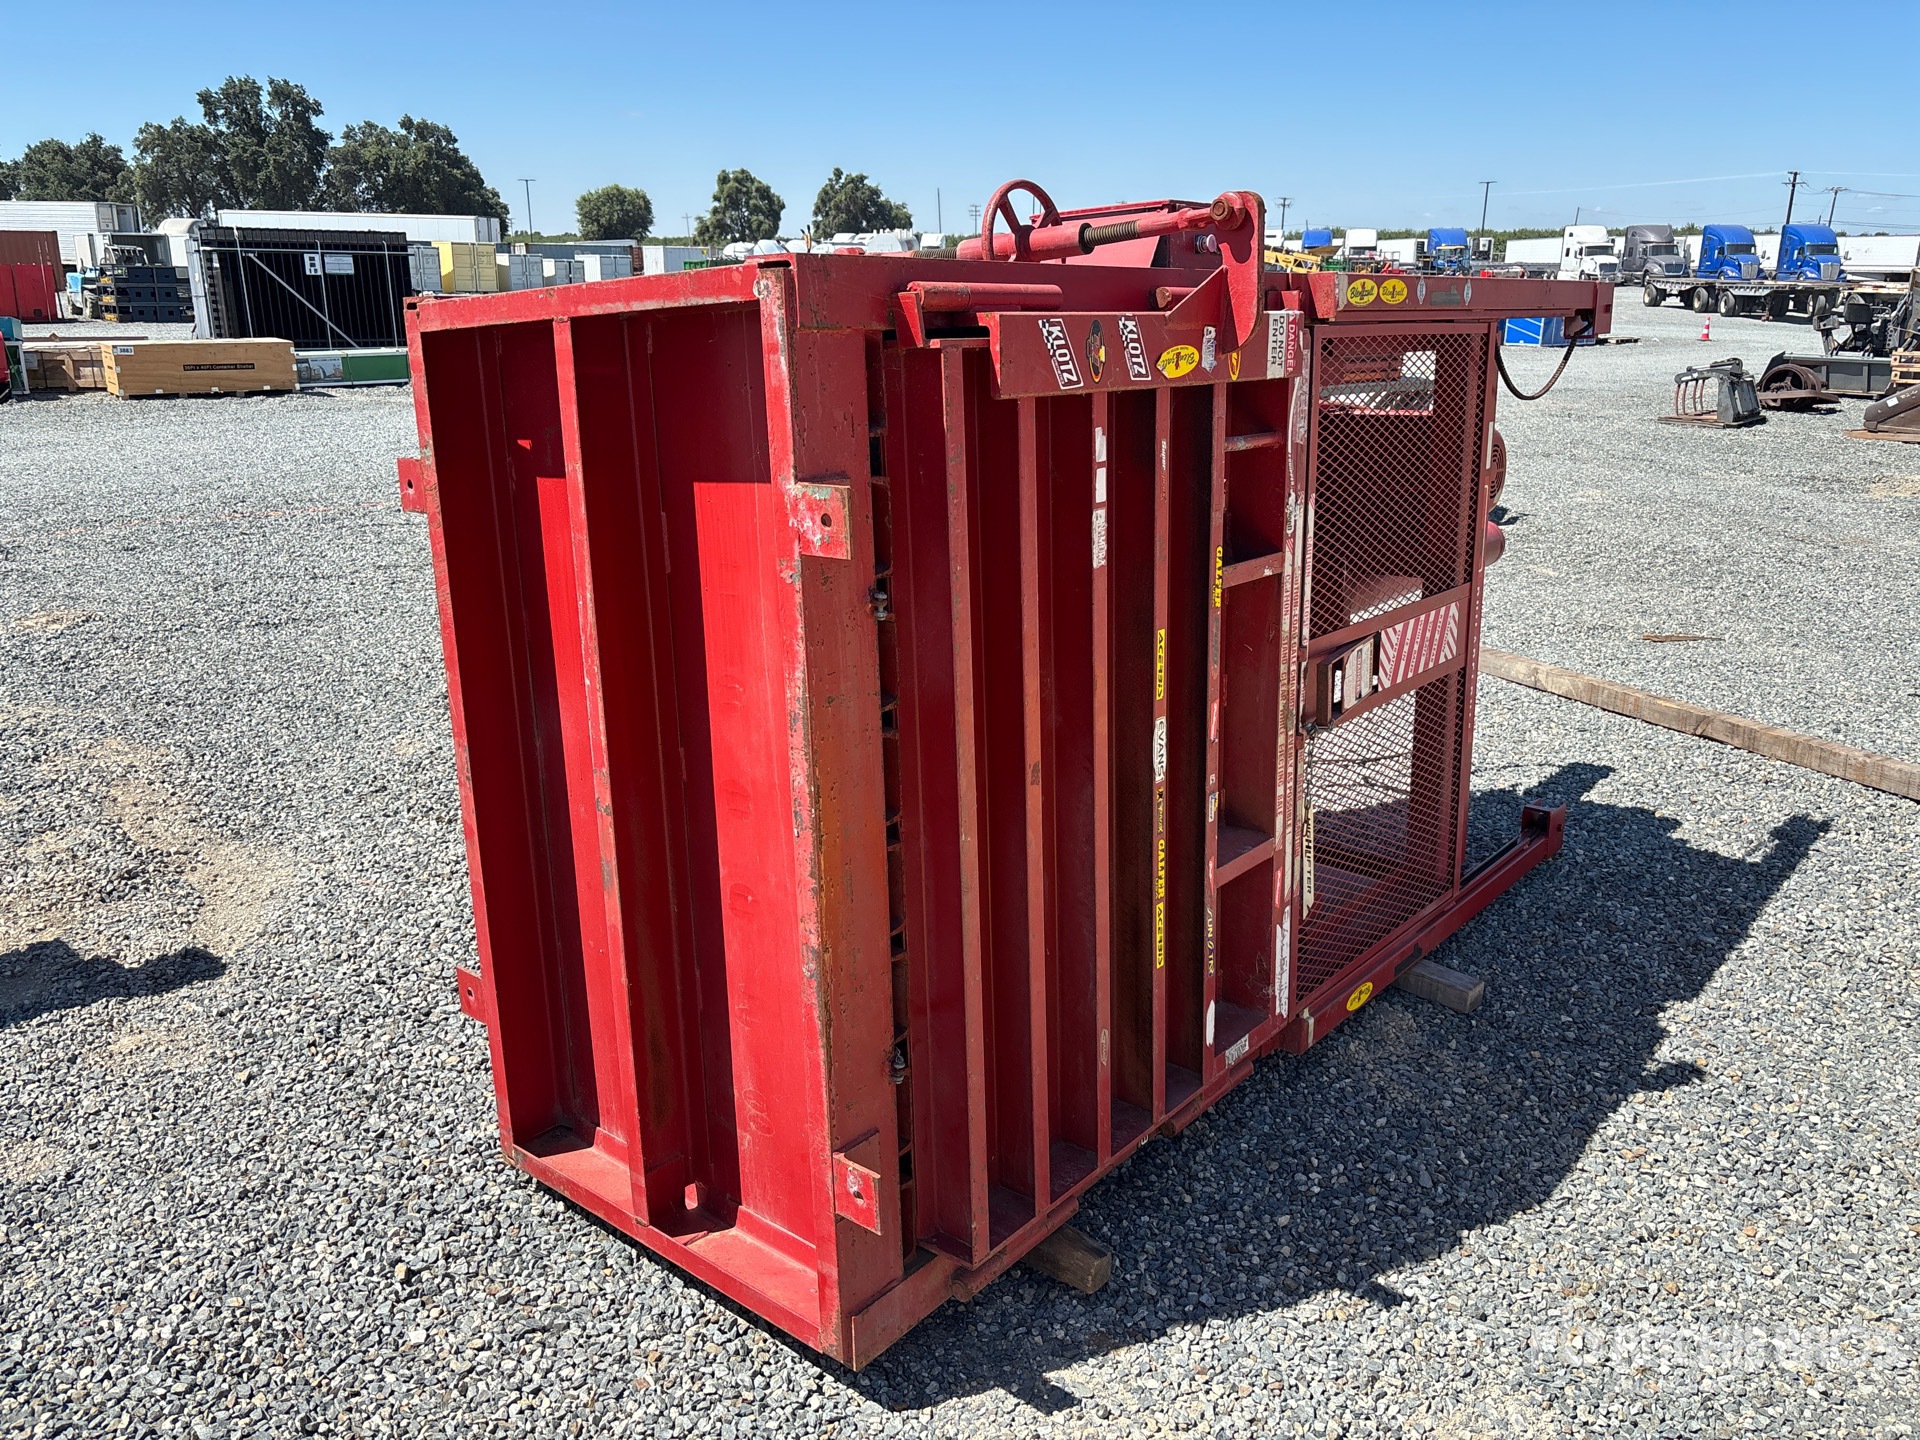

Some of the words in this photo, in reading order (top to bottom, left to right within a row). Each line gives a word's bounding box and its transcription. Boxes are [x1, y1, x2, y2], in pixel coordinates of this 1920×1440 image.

[1124, 320, 1147, 374] KLOTZ
[1279, 316, 1285, 335] DO
[1048, 325, 1078, 382] KLOTZ
[1214, 545, 1223, 608] GALFER
[1387, 629, 1400, 681] OPERATION
[1415, 619, 1423, 645] WHILE
[1441, 615, 1452, 652] CAUTION
[1157, 720, 1165, 776] EVANS
[1287, 771, 1294, 783] AS
